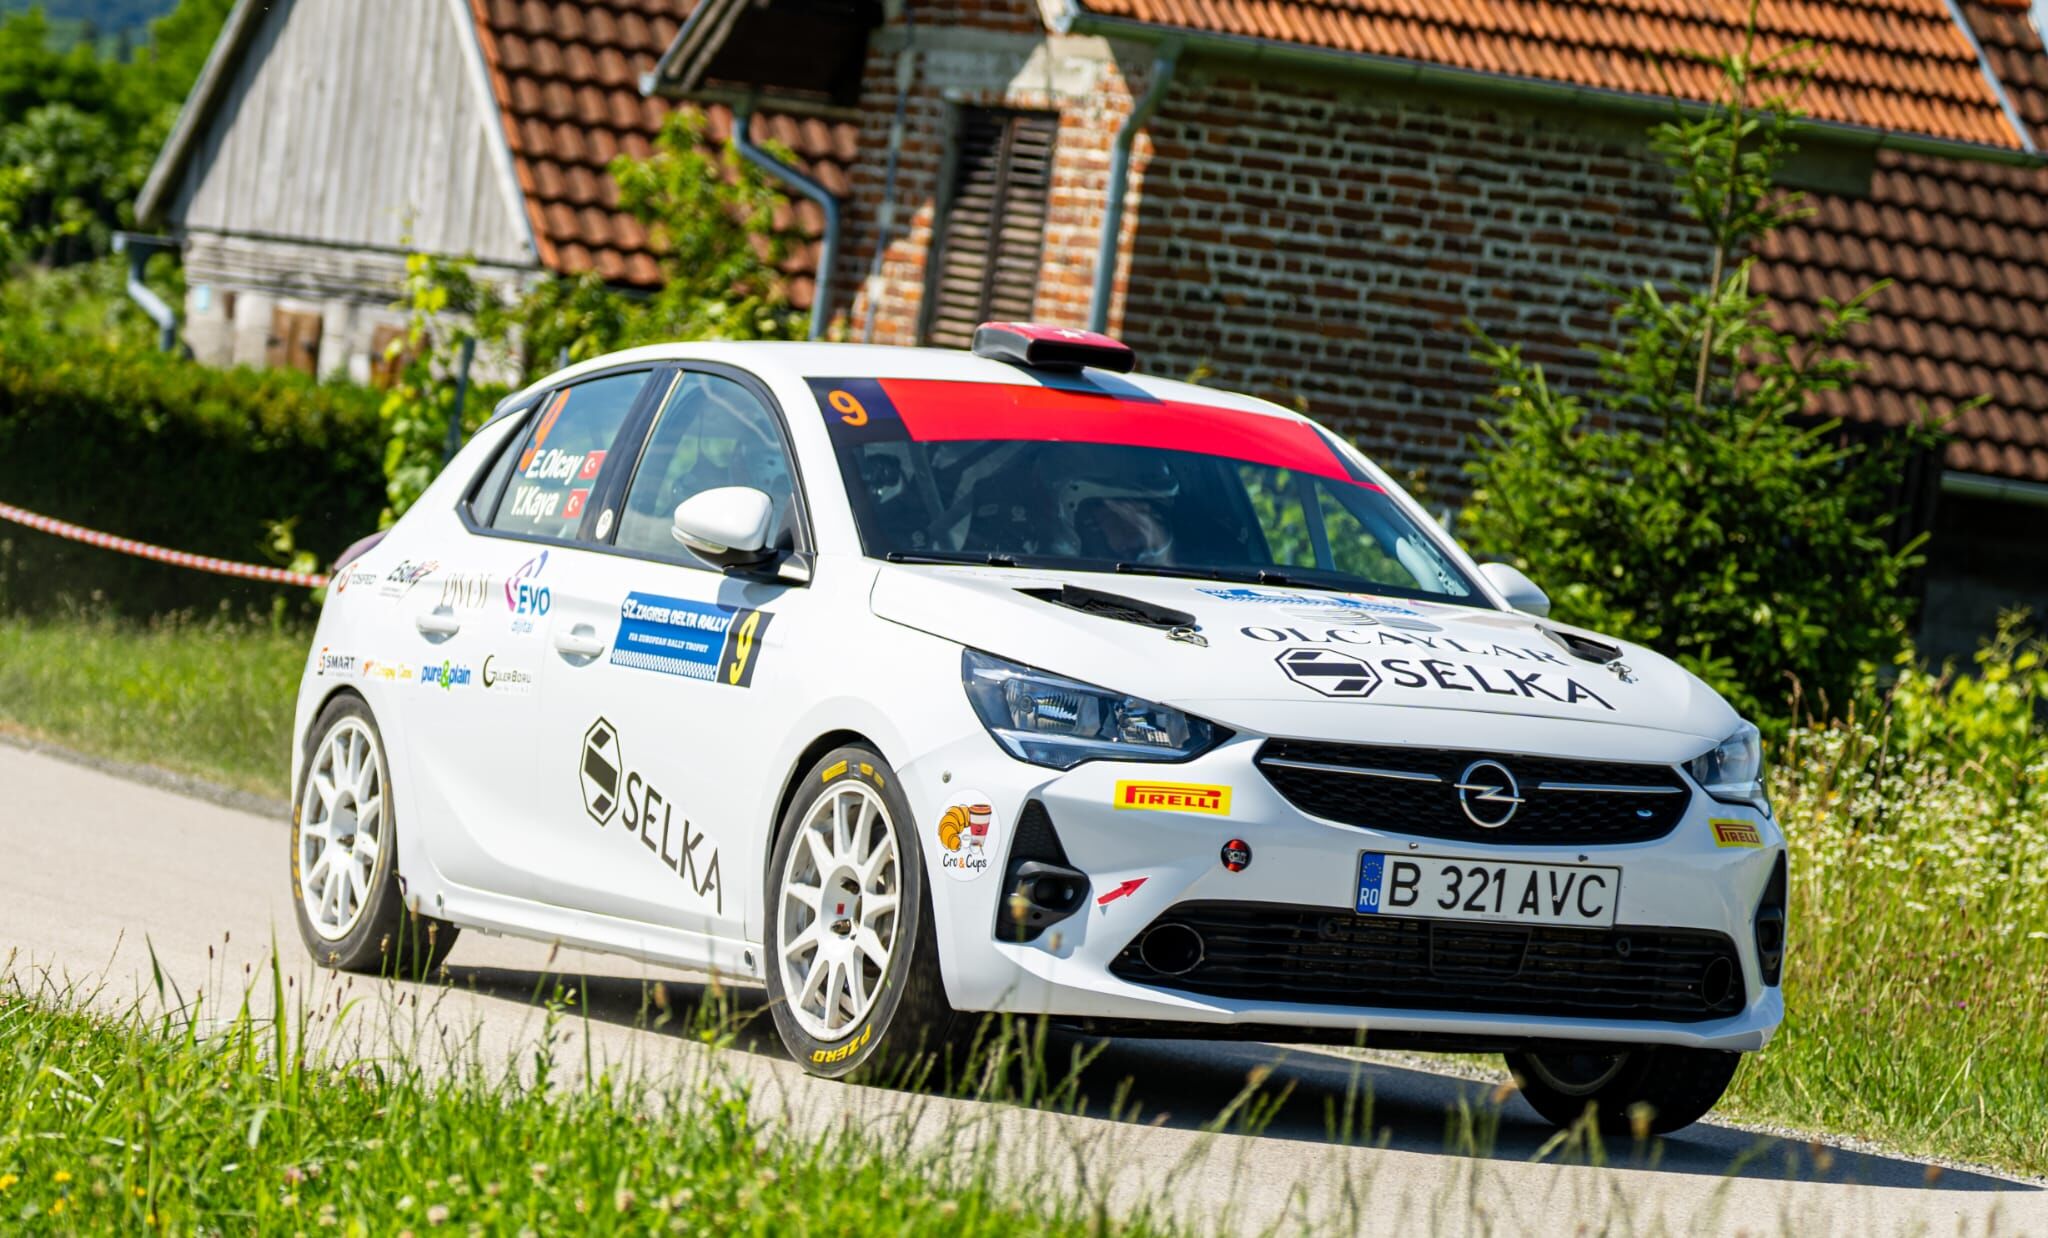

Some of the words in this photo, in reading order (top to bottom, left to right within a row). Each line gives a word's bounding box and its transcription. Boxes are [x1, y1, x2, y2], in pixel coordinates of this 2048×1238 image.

[828, 390, 868, 426] 9
[525, 448, 585, 486] E.Olcay
[511, 486, 560, 524] Y.Kaya
[517, 584, 551, 616] EVO
[669, 609, 699, 629] DELTA
[697, 614, 730, 633] RALLY
[638, 634, 667, 646] EUROPEAN
[666, 638, 686, 650] RALLY
[685, 641, 709, 653] TROPHY
[729, 611, 761, 685] 9
[1239, 626, 1573, 667] OLCAYLAR
[326, 655, 355, 670] SMART
[1381, 658, 1617, 711] SELKA
[1125, 785, 1223, 810] PIRELLI
[622, 771, 722, 915] SELKA
[1713, 823, 1761, 845] PIRELLI
[966, 853, 987, 873] Cups
[1359, 887, 1380, 907] RO
[1388, 861, 1422, 908] B
[1437, 865, 1506, 914] 321
[1517, 870, 1607, 919] AVC
